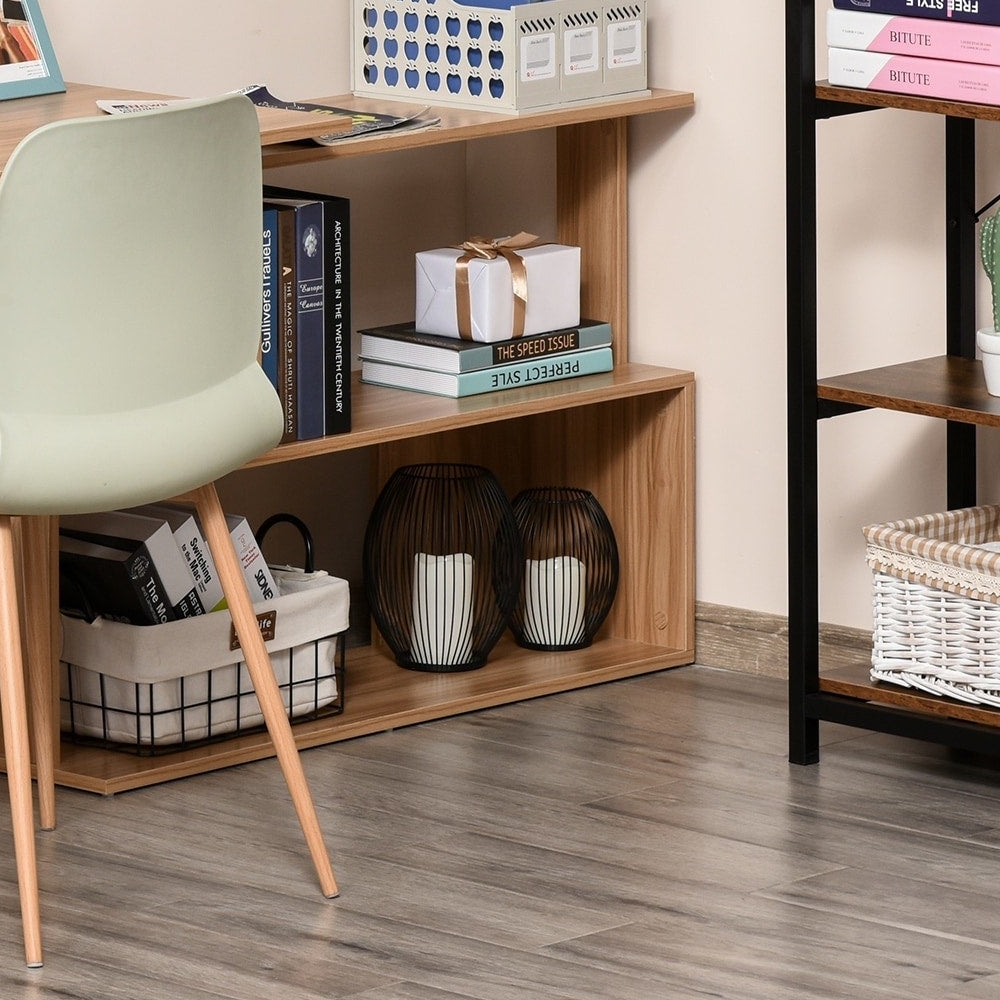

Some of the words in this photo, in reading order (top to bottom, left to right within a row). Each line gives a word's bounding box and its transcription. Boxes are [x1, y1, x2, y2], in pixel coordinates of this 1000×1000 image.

[889, 30, 932, 47] BITUTE
[889, 69, 931, 86] BITUTE
[334, 220, 342, 285] ARCHITECTURE
[335, 288, 342, 299] IN
[335, 302, 343, 320] THE
[287, 340, 293, 354] OF
[335, 322, 343, 372] TWENTIETH
[497, 344, 516, 361] THE
[517, 339, 546, 358] SPEED
[547, 333, 575, 352] ISSUE
[491, 370, 521, 388] SYLE
[525, 360, 580, 382] PERFECT
[335, 373, 343, 414] CENTURY
[181, 543, 187, 552] to
[184, 551, 192, 563] the
[189, 559, 202, 582] Mac
[189, 537, 212, 585] Switching
[146, 576, 159, 604] The
[179, 599, 191, 619] IGL
[188, 591, 204, 616] ASTR
